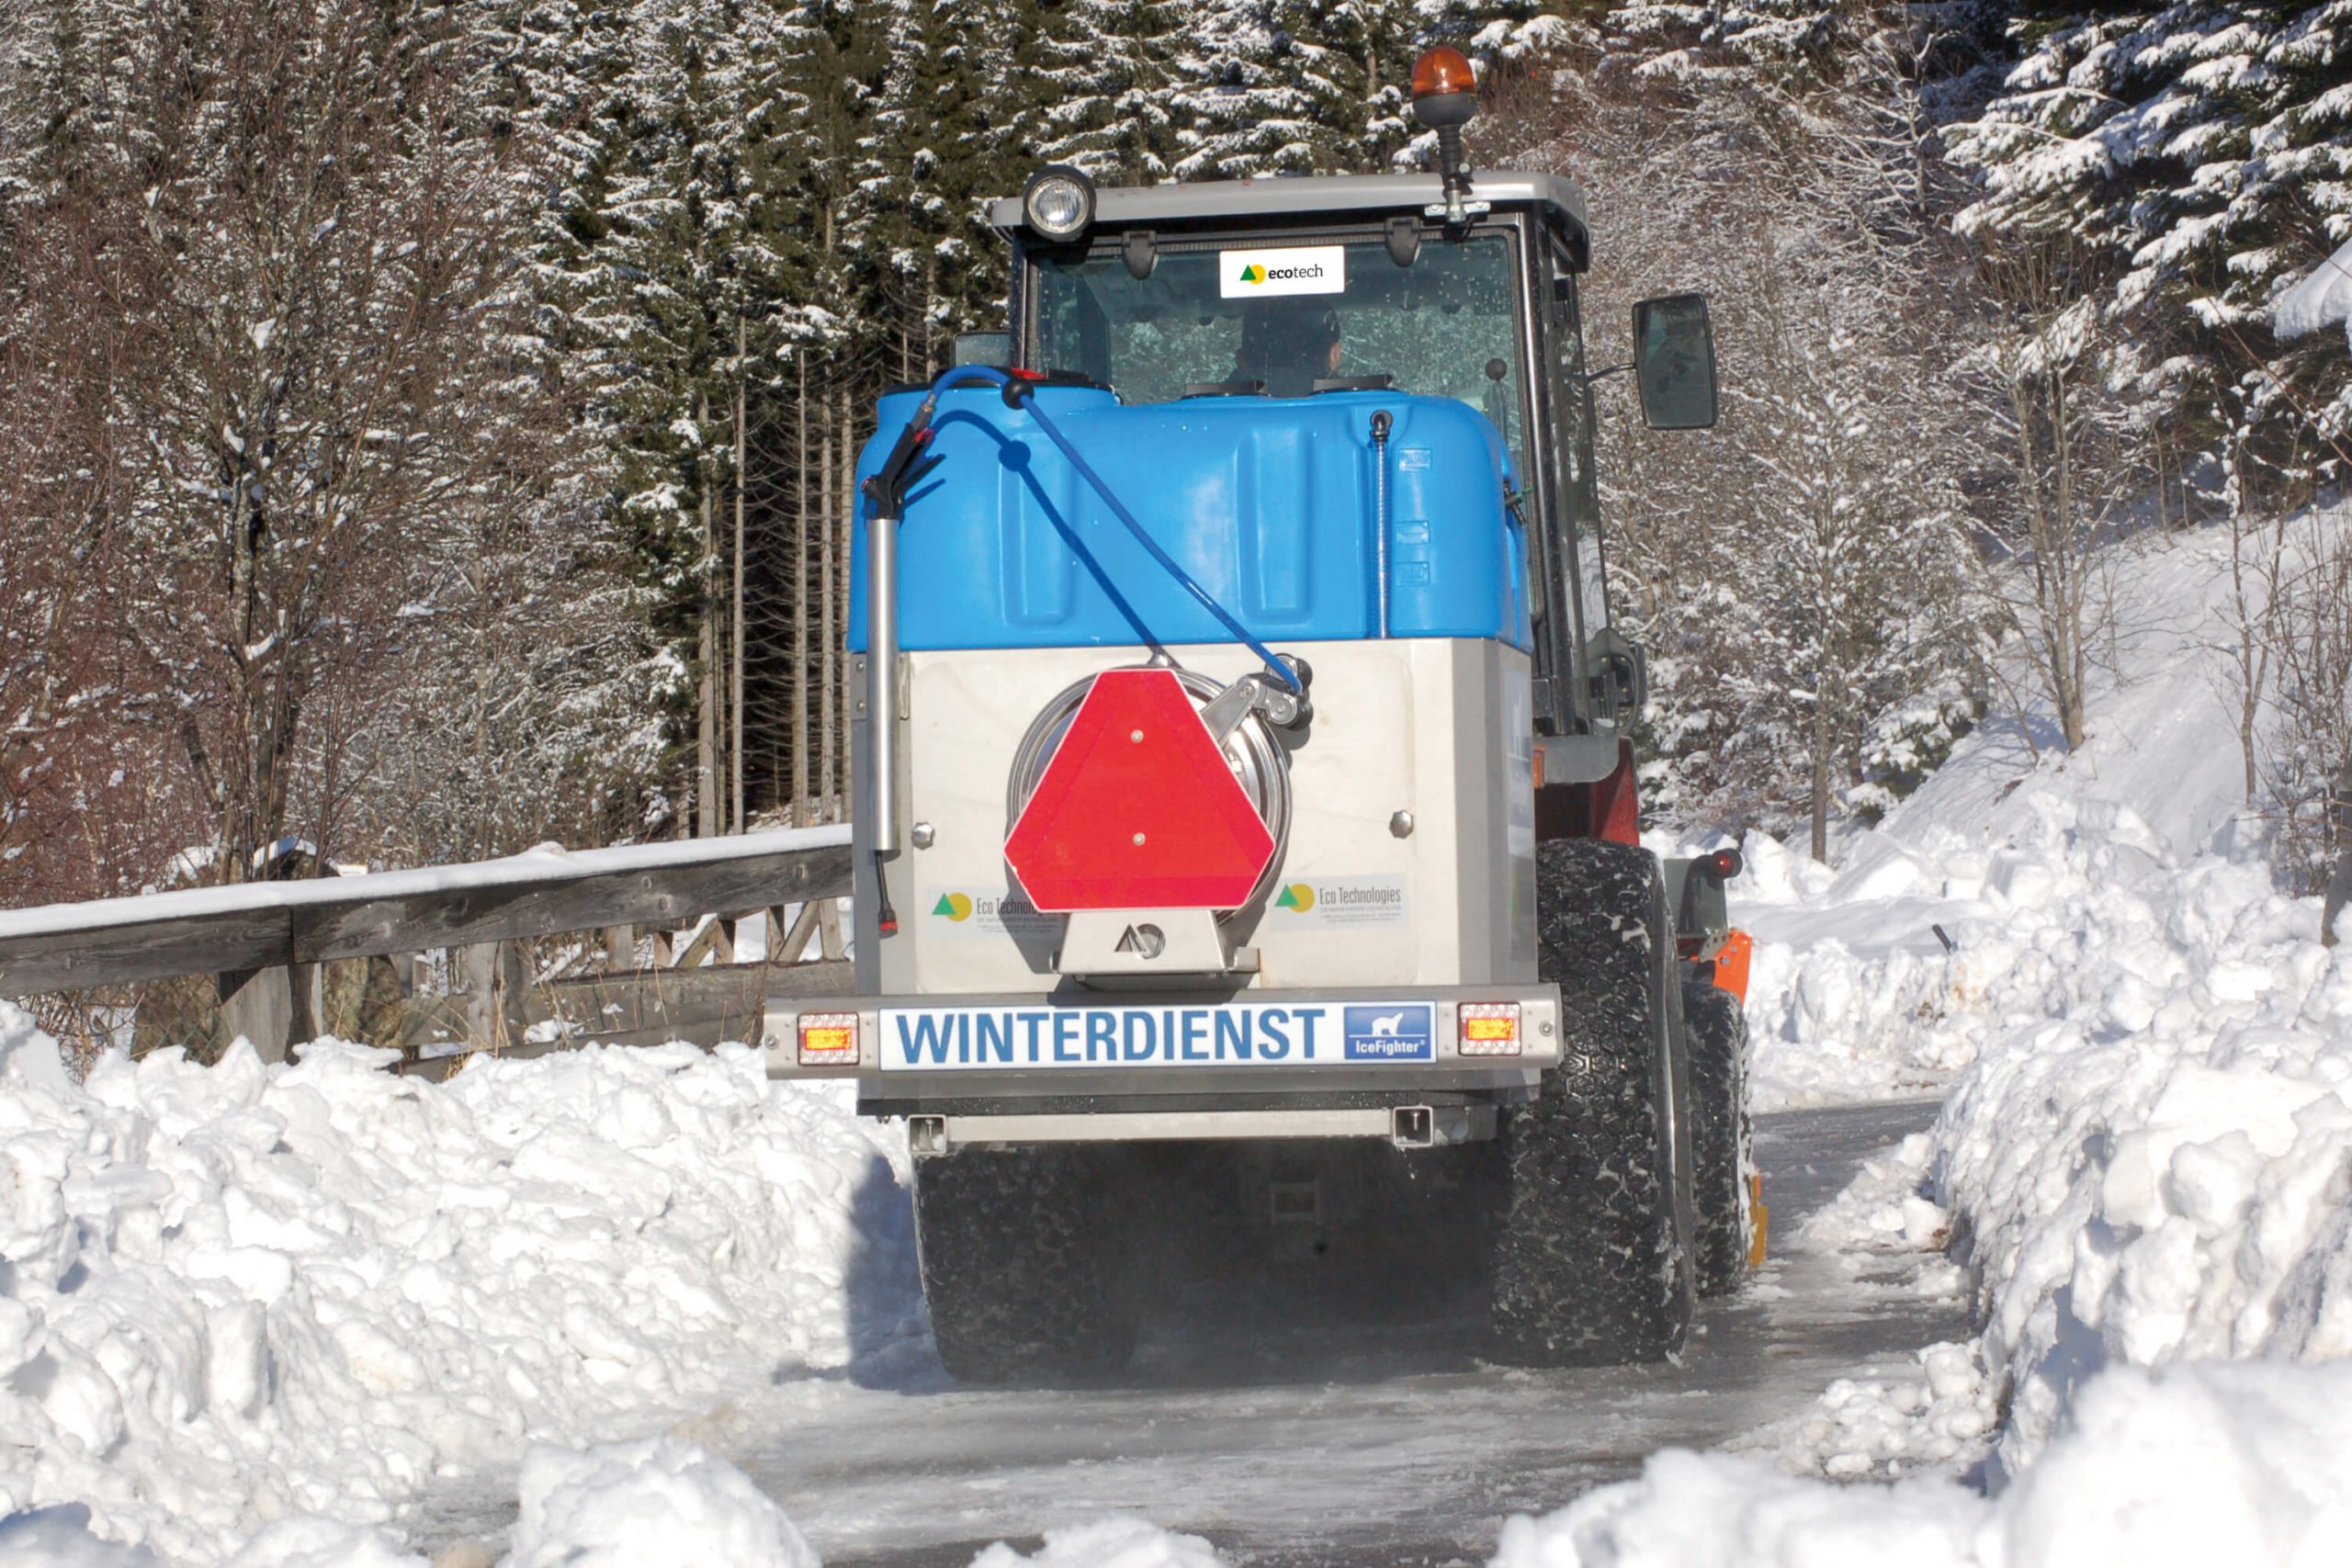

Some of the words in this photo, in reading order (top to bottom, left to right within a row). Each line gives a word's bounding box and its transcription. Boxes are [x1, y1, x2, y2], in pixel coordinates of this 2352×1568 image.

[1268, 264, 1323, 279] ecotech
[1319, 887, 1336, 905] Eco
[1339, 886, 1401, 905] Technologies
[977, 897, 994, 915] Eco
[896, 1009, 1326, 1065] WINTERDIENST
